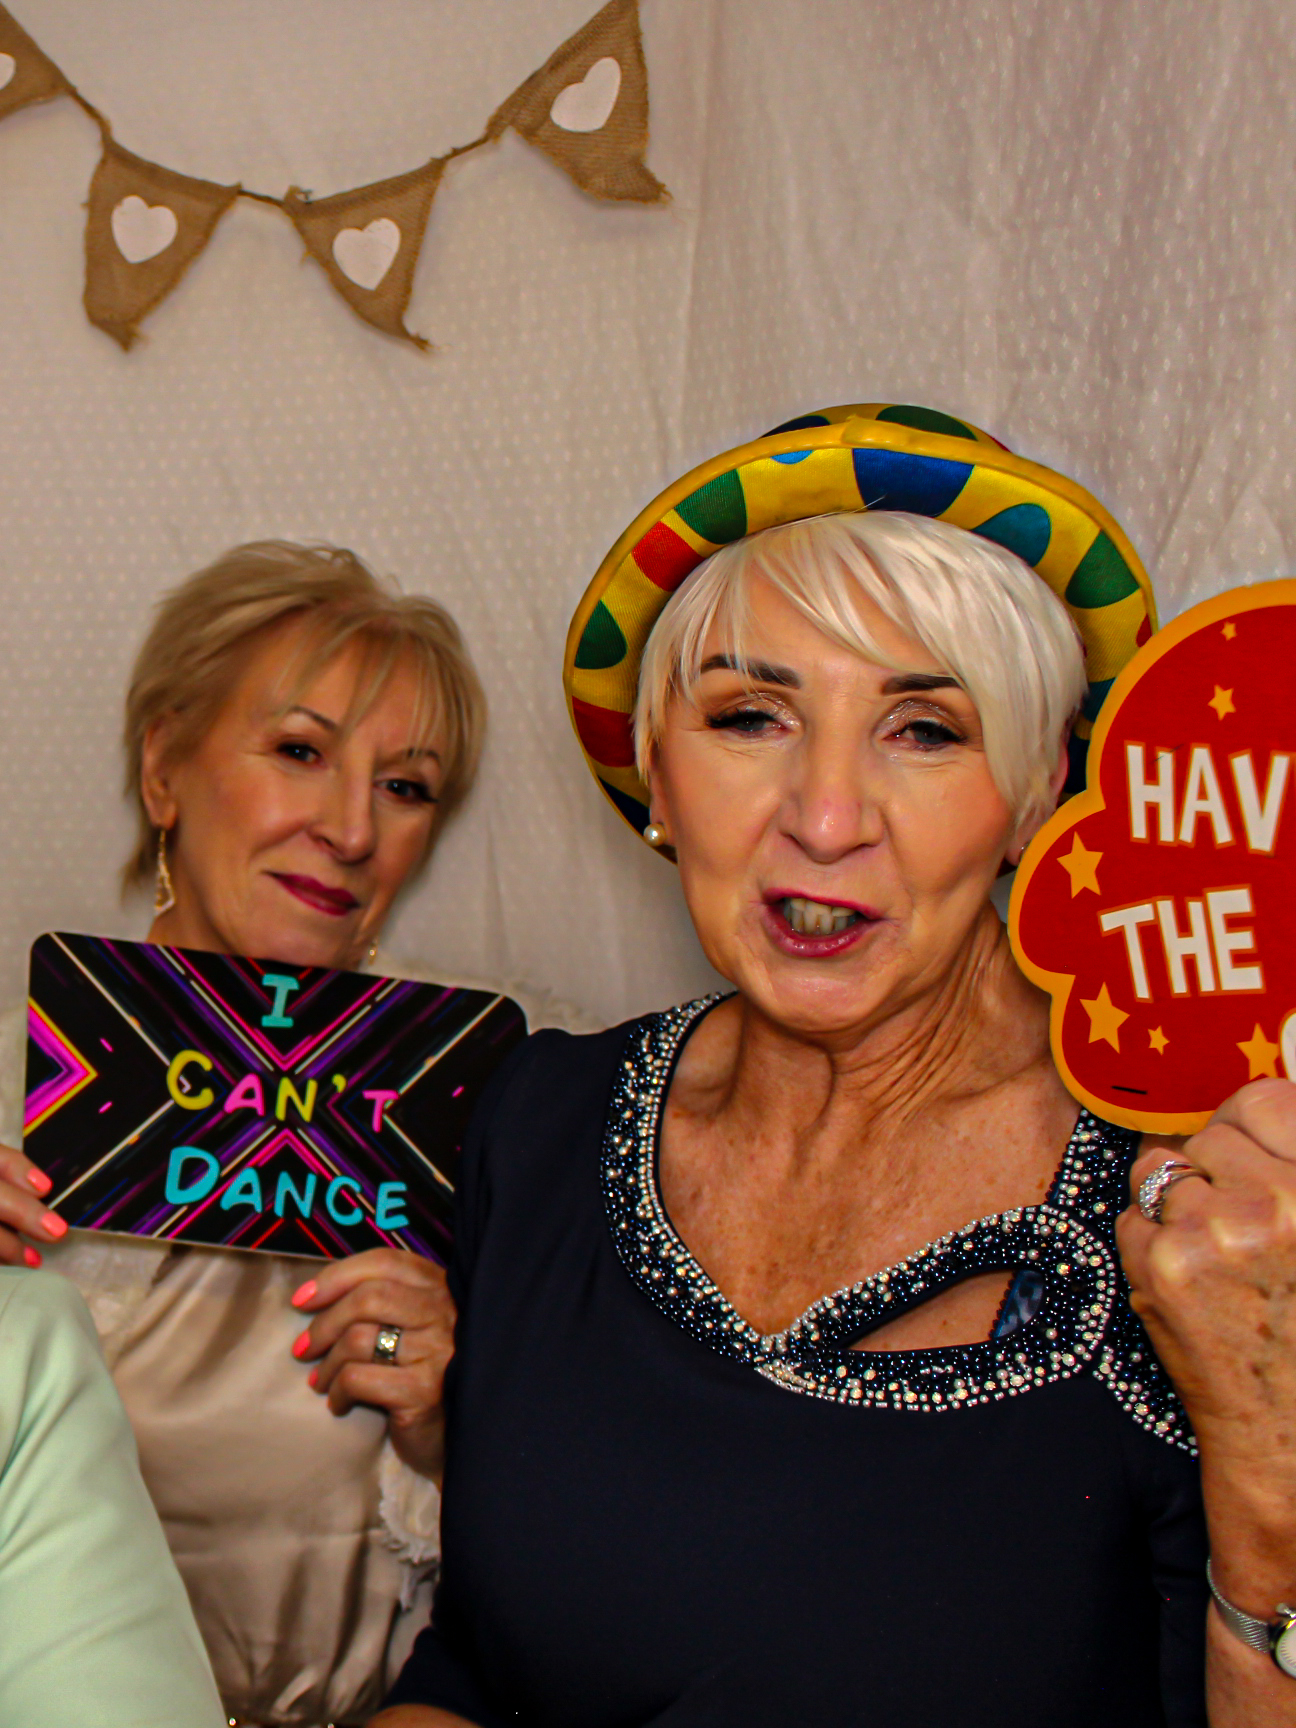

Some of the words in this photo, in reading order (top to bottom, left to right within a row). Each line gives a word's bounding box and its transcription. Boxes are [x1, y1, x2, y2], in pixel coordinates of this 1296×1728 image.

[1125, 740, 1296, 854] HAV
[1100, 886, 1265, 1001] THE
[261, 973, 300, 1028] I
[166, 1049, 400, 1132] CAN'T
[165, 1146, 410, 1231] DANCE
